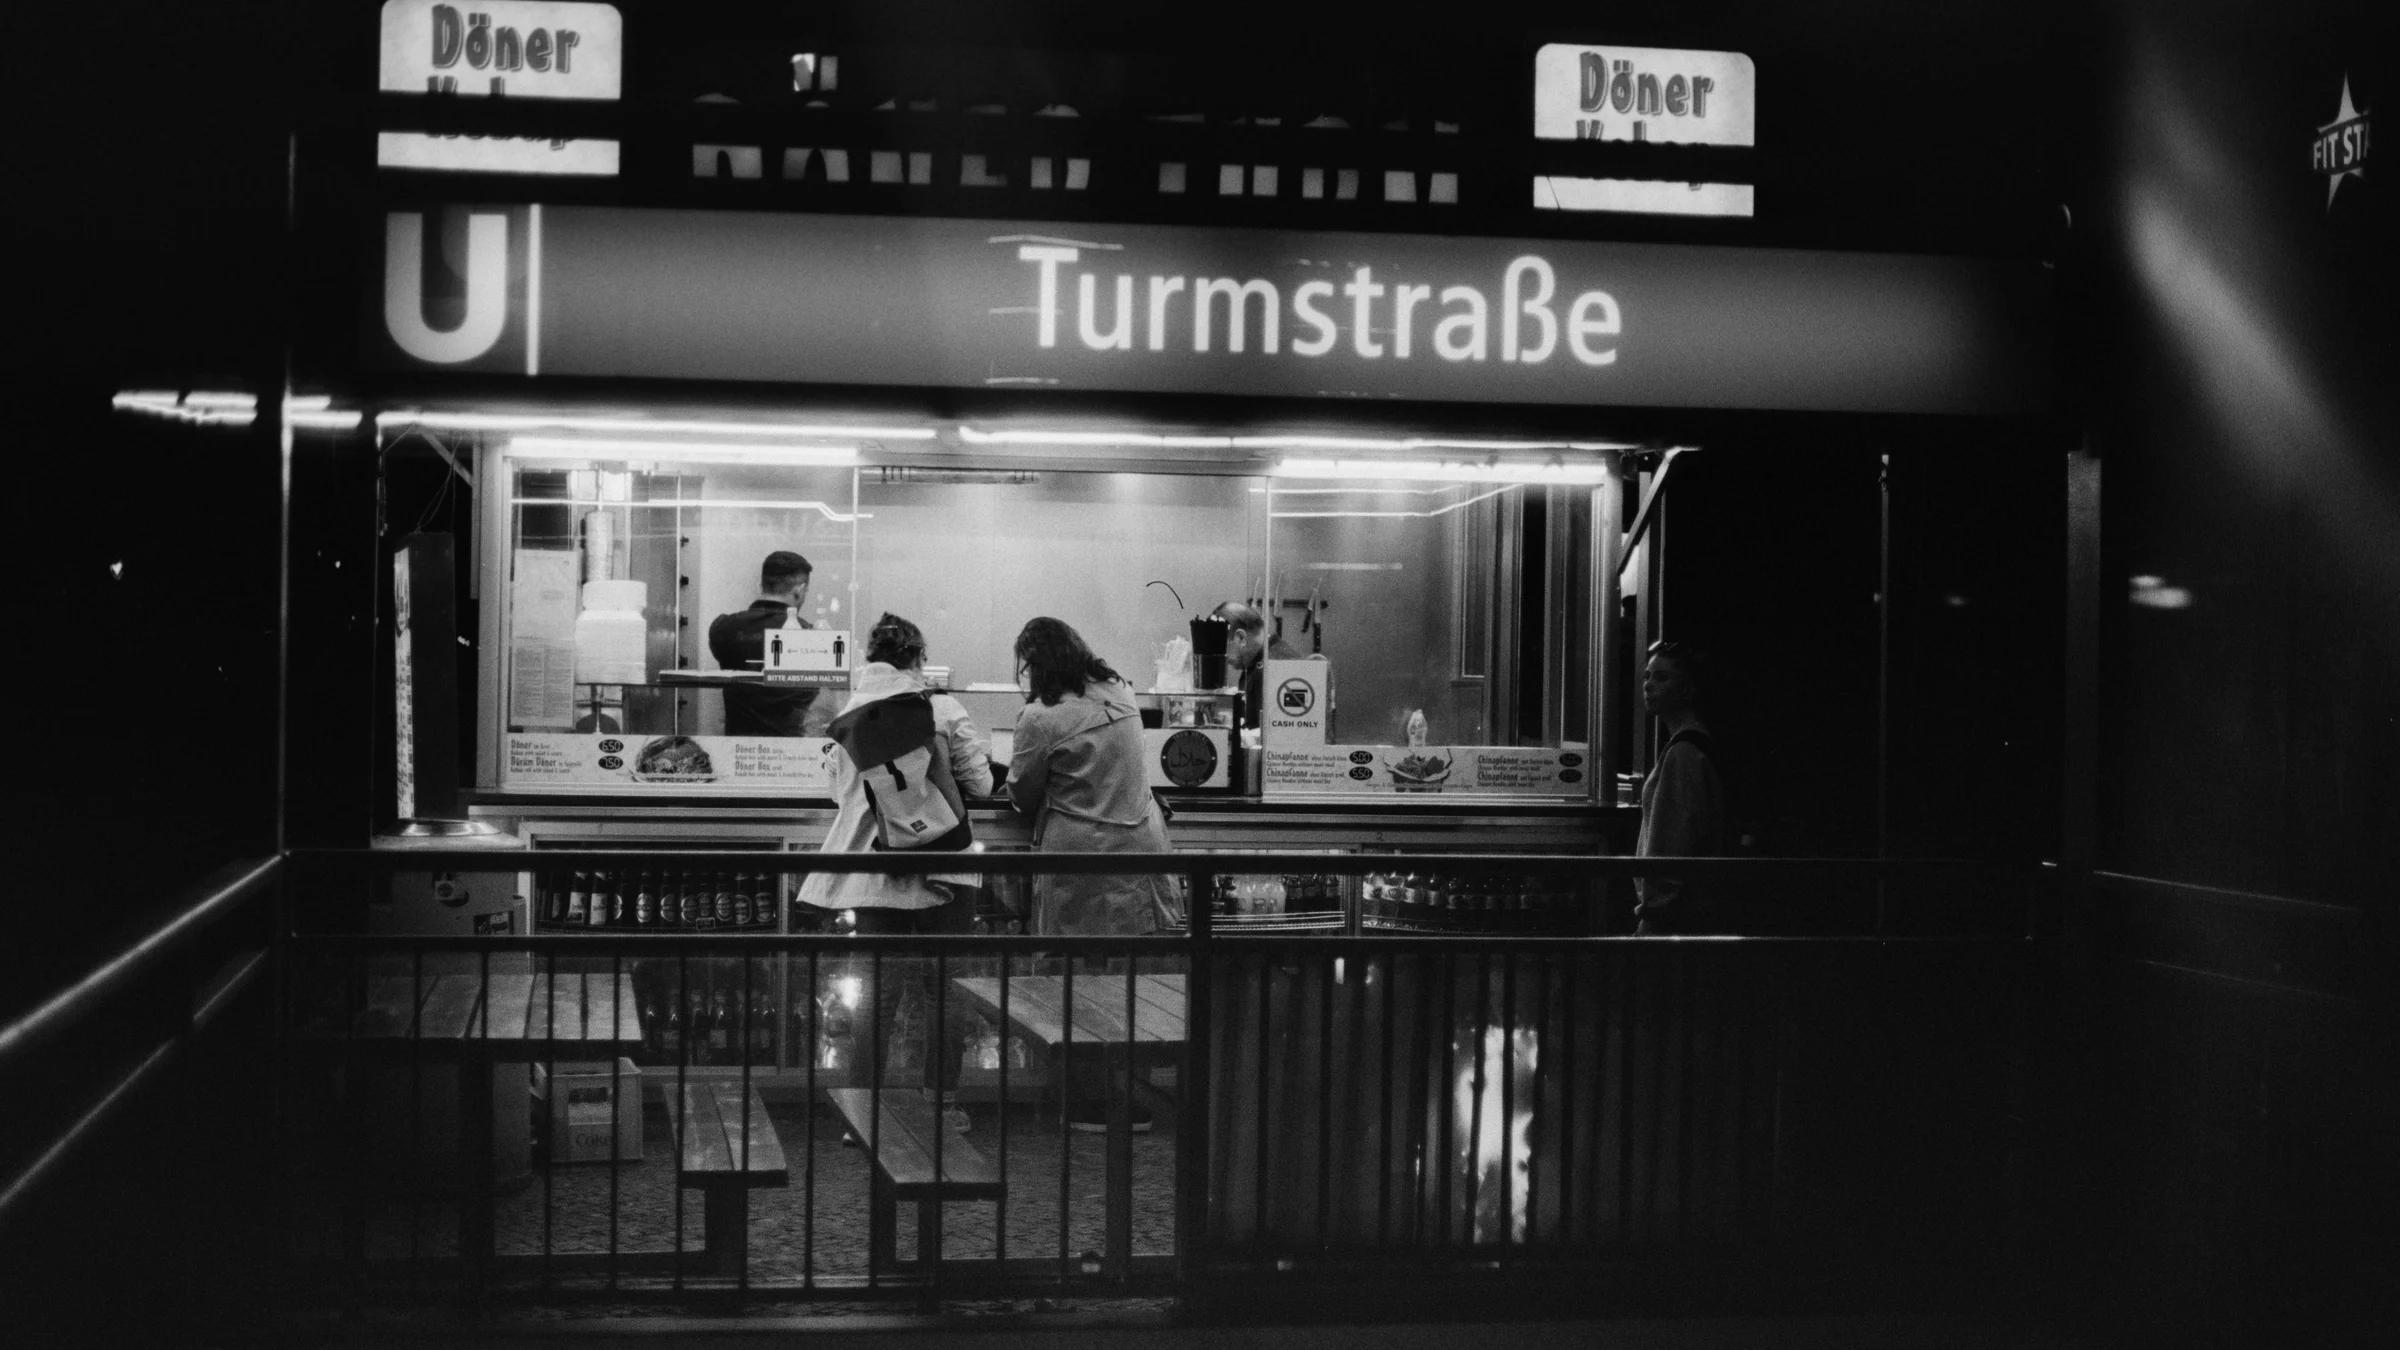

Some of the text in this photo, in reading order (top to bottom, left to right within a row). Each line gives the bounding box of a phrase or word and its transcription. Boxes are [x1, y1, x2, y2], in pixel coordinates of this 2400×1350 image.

[430, 4, 580, 75] Döner
[1579, 51, 1715, 118] Döner
[2313, 131, 2338, 170] FIT
[385, 212, 508, 364] U
[1018, 243, 1623, 367] Turmstraße
[1272, 720, 1319, 728] CASH ONLY
